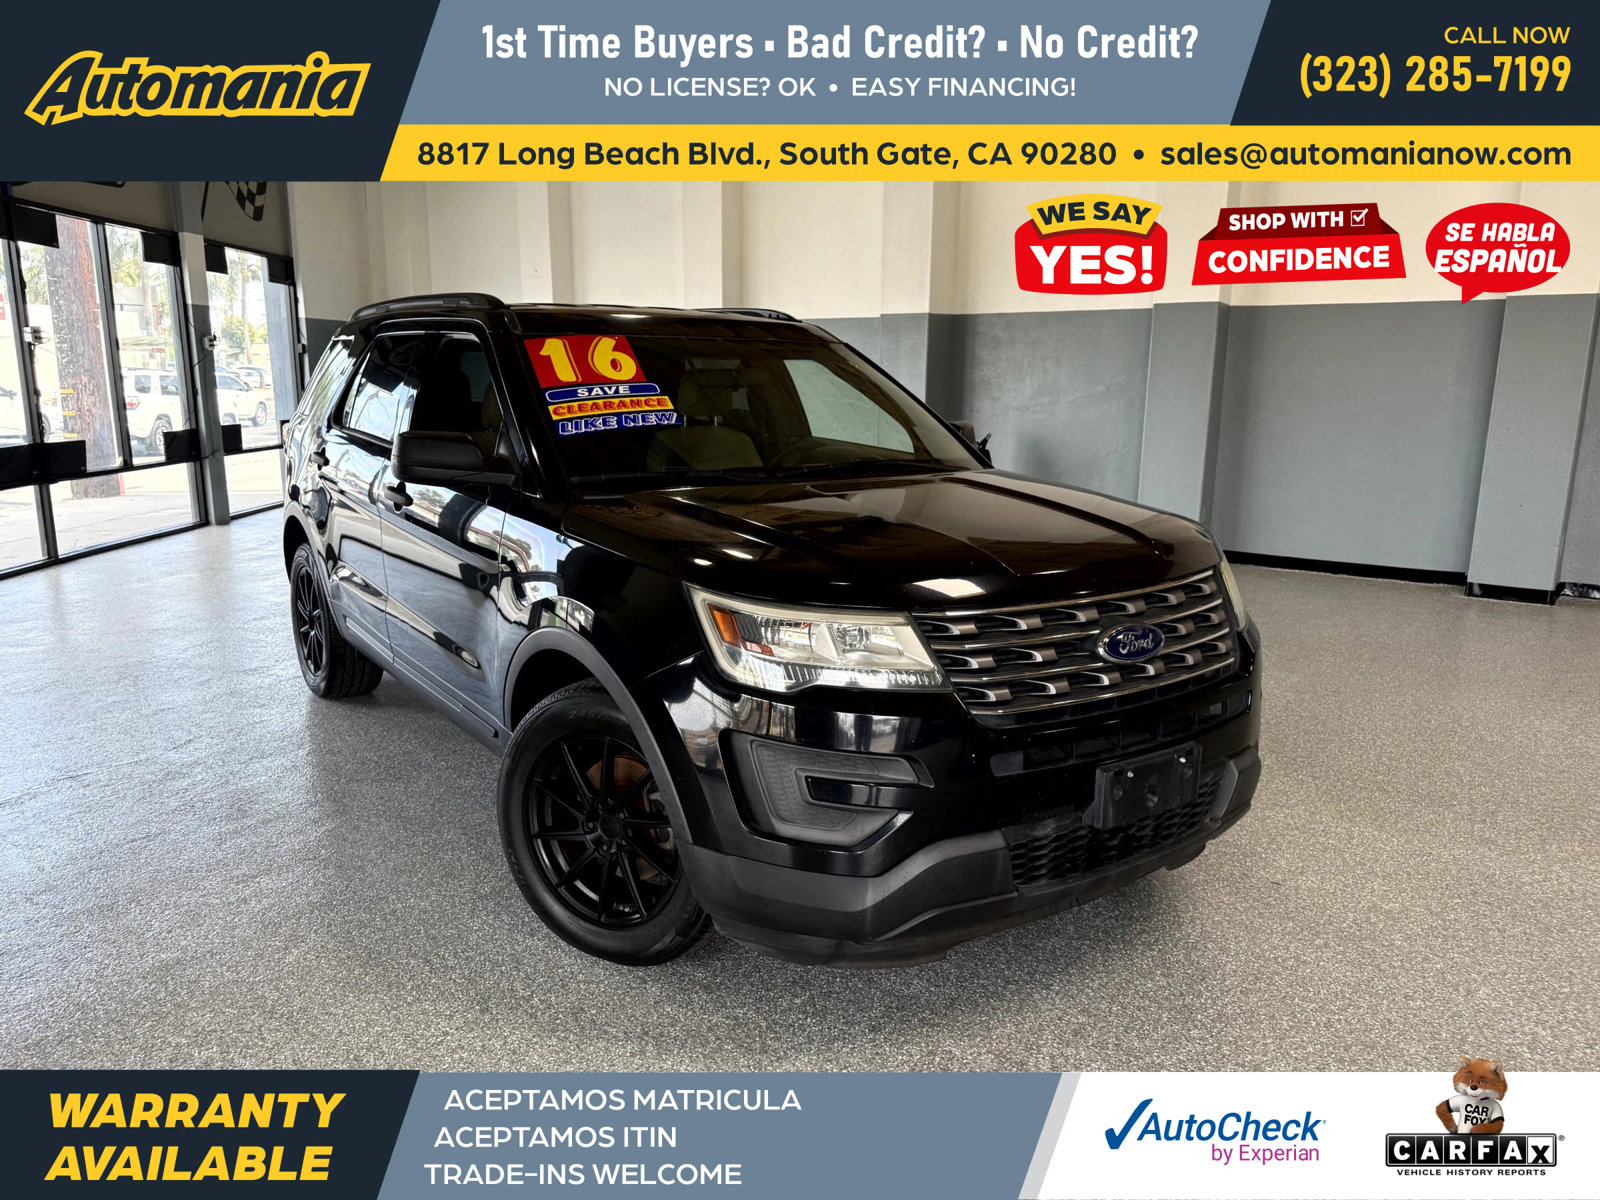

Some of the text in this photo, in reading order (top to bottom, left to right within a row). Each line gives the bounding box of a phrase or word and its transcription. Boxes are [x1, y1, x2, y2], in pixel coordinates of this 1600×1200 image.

[539, 335, 637, 382] 16
[577, 385, 630, 397] SAVE
[552, 398, 668, 417] CLEARANCE
[559, 411, 678, 435] LIKE NEW
[1118, 631, 1155, 655] Ford
